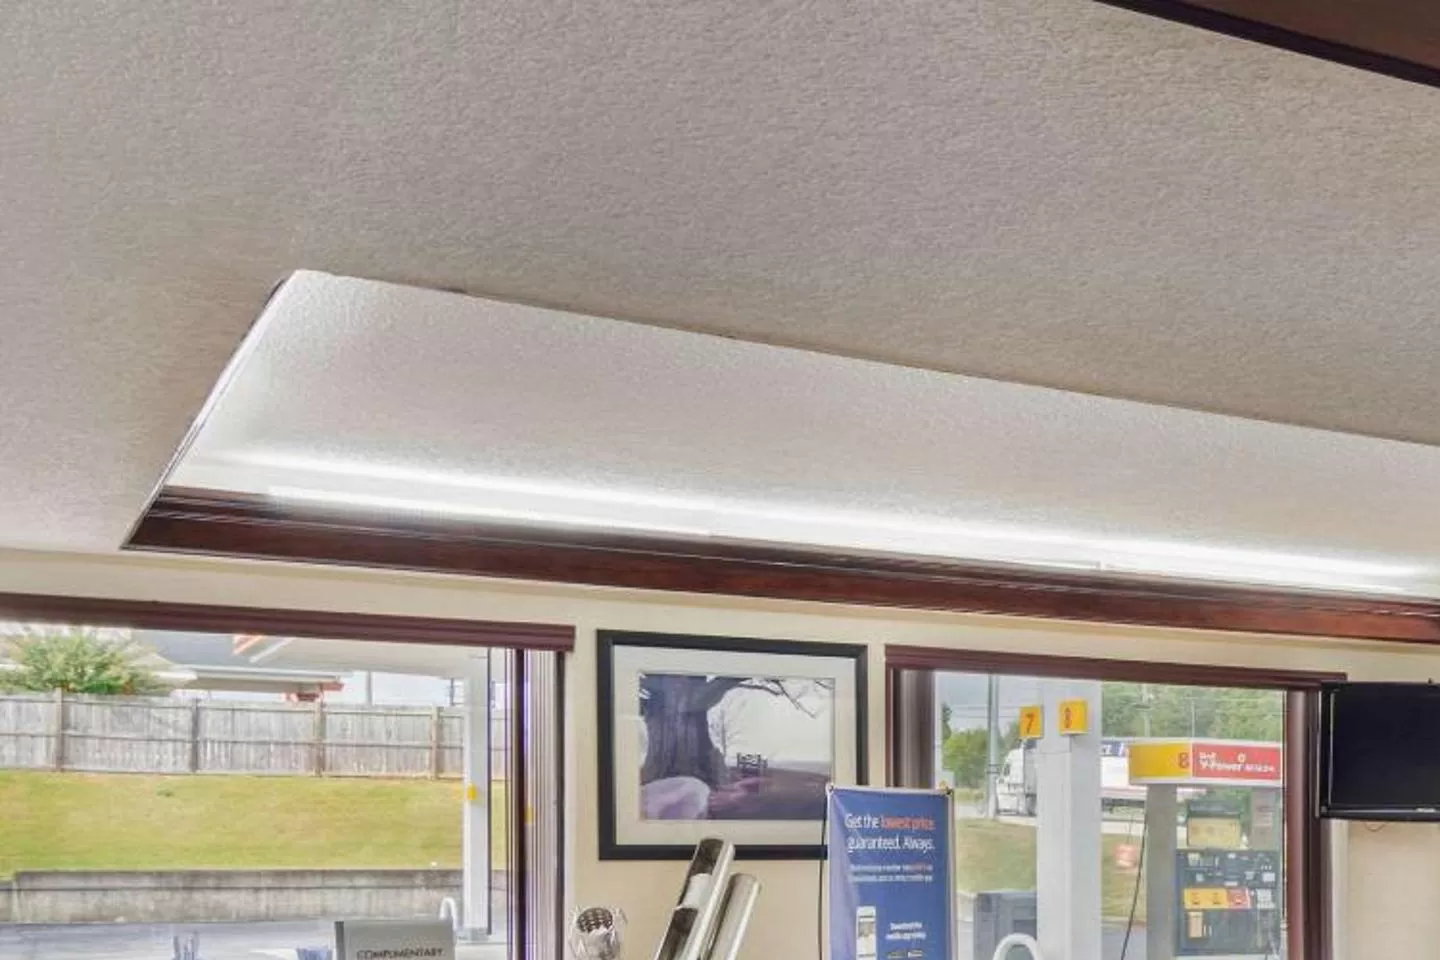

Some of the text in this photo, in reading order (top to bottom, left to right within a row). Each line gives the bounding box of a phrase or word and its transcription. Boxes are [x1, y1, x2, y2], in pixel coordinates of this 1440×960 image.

[1023, 713, 1035, 734] 7
[1178, 752, 1189, 769] 8
[845, 814, 863, 829] Get
[864, 814, 880, 829] the
